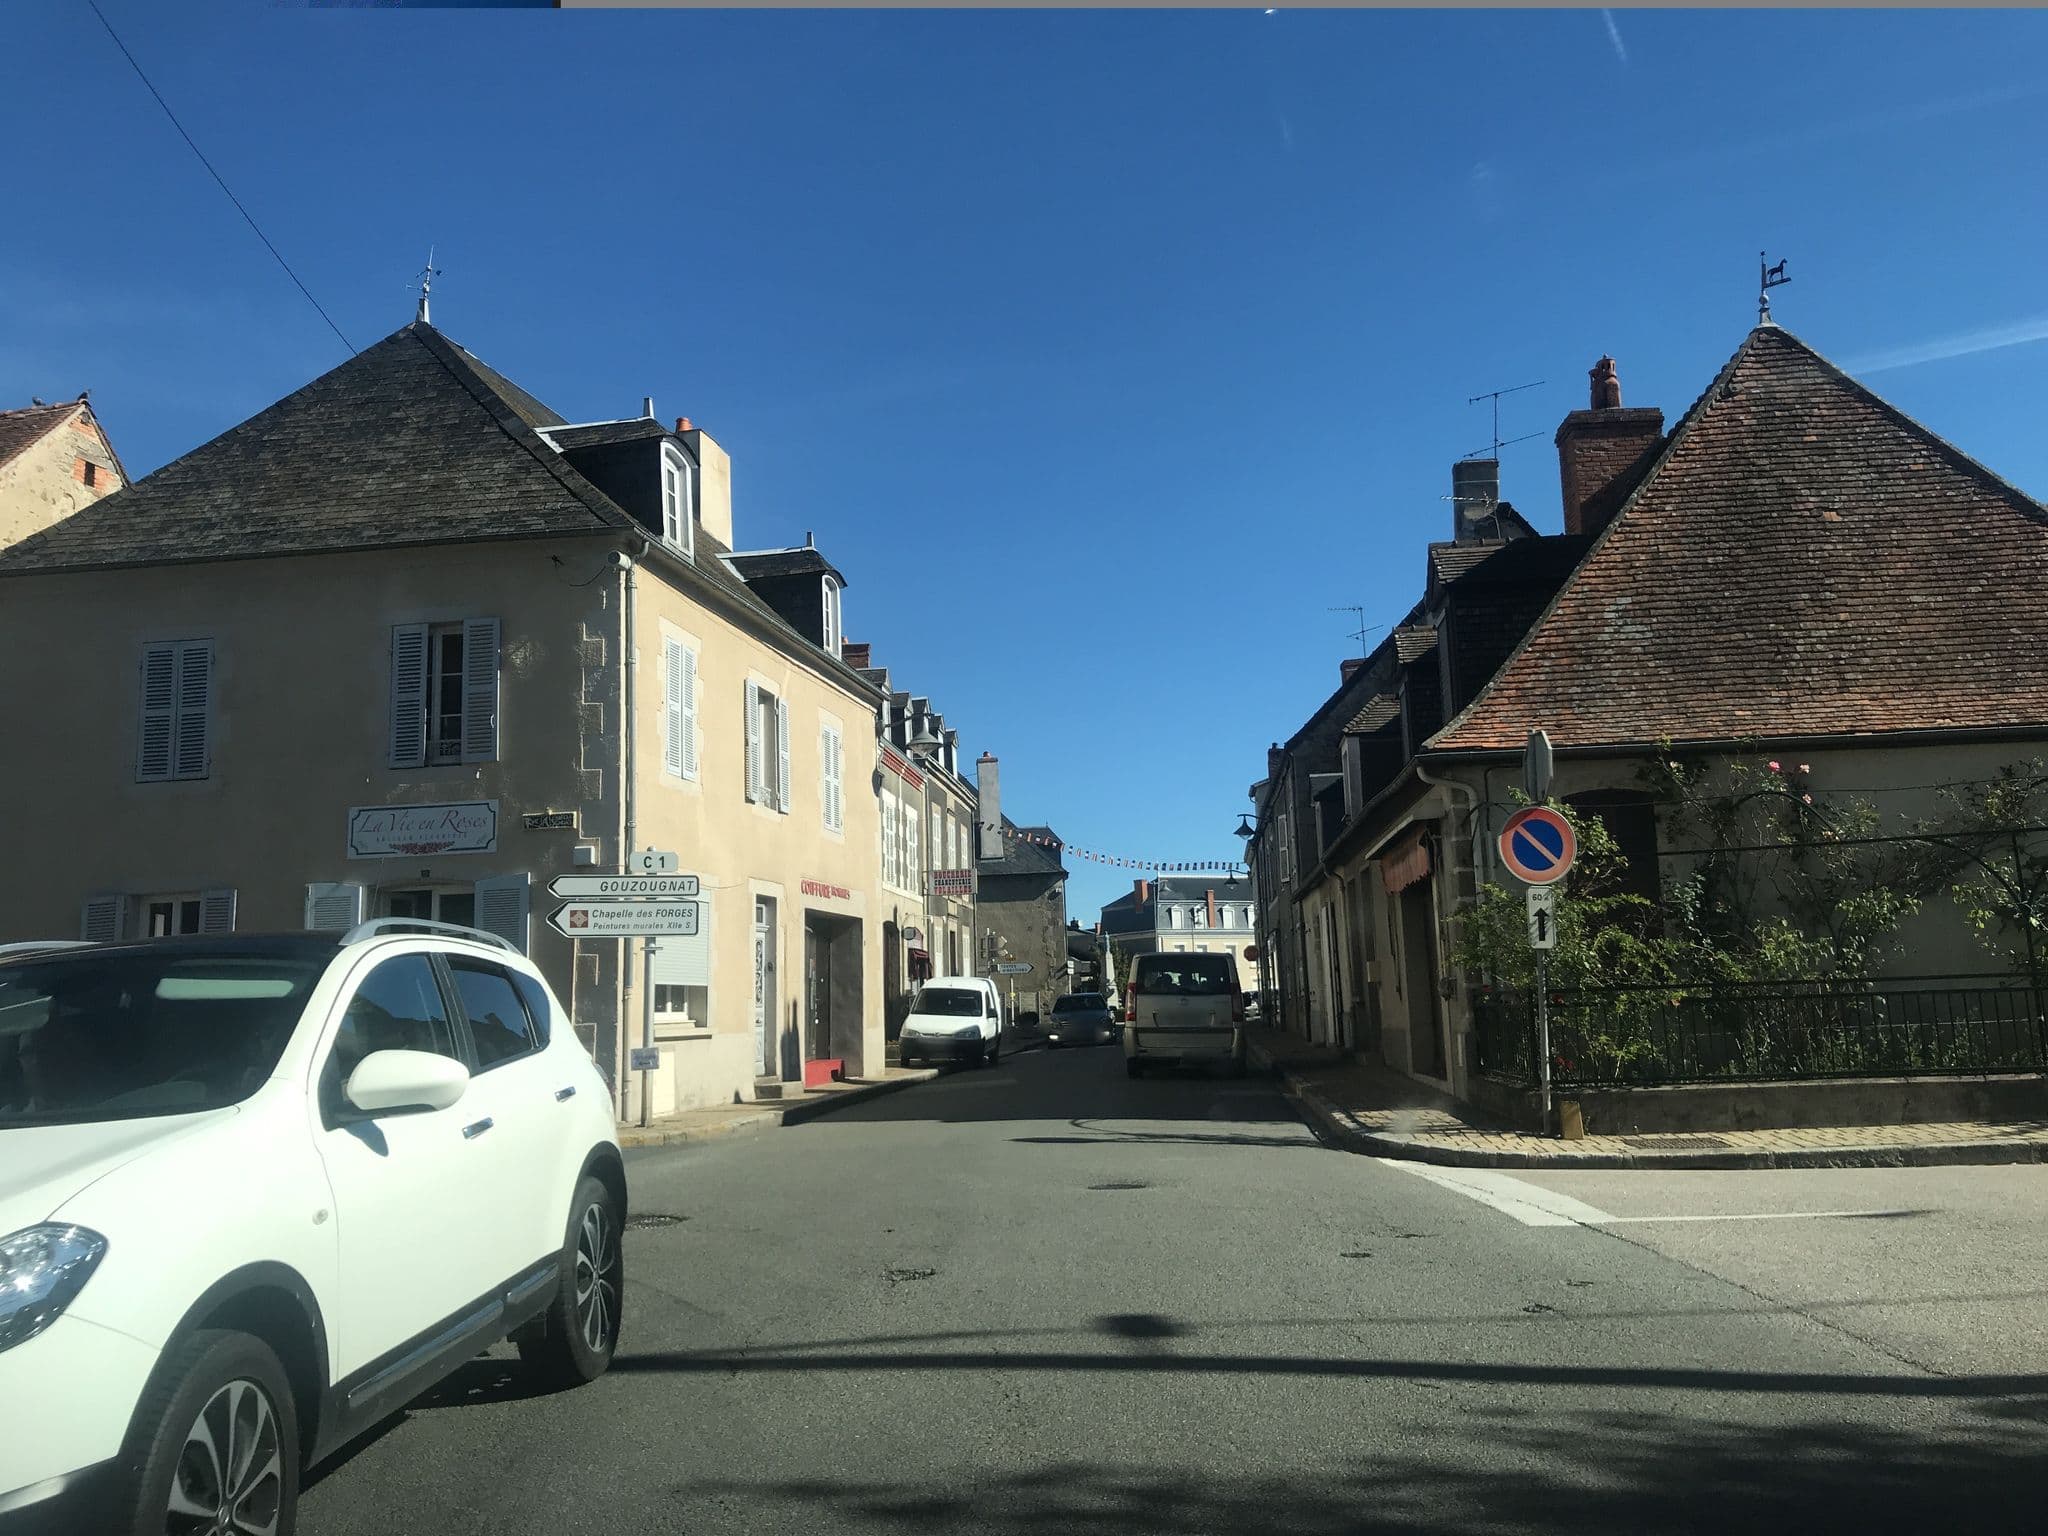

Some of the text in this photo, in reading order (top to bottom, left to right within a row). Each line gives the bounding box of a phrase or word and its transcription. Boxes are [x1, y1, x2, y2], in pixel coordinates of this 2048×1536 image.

[359, 809, 488, 834] La Vie en Roses
[643, 856, 665, 869] C 1
[934, 870, 972, 879] BOUCHERIE
[600, 880, 694, 892] GOUZOUGNAT
[800, 879, 831, 899] COIFFURE
[592, 908, 693, 920] Chapelle des FORGES
[593, 922, 630, 930] Peintures
[633, 922, 664, 930] murales
